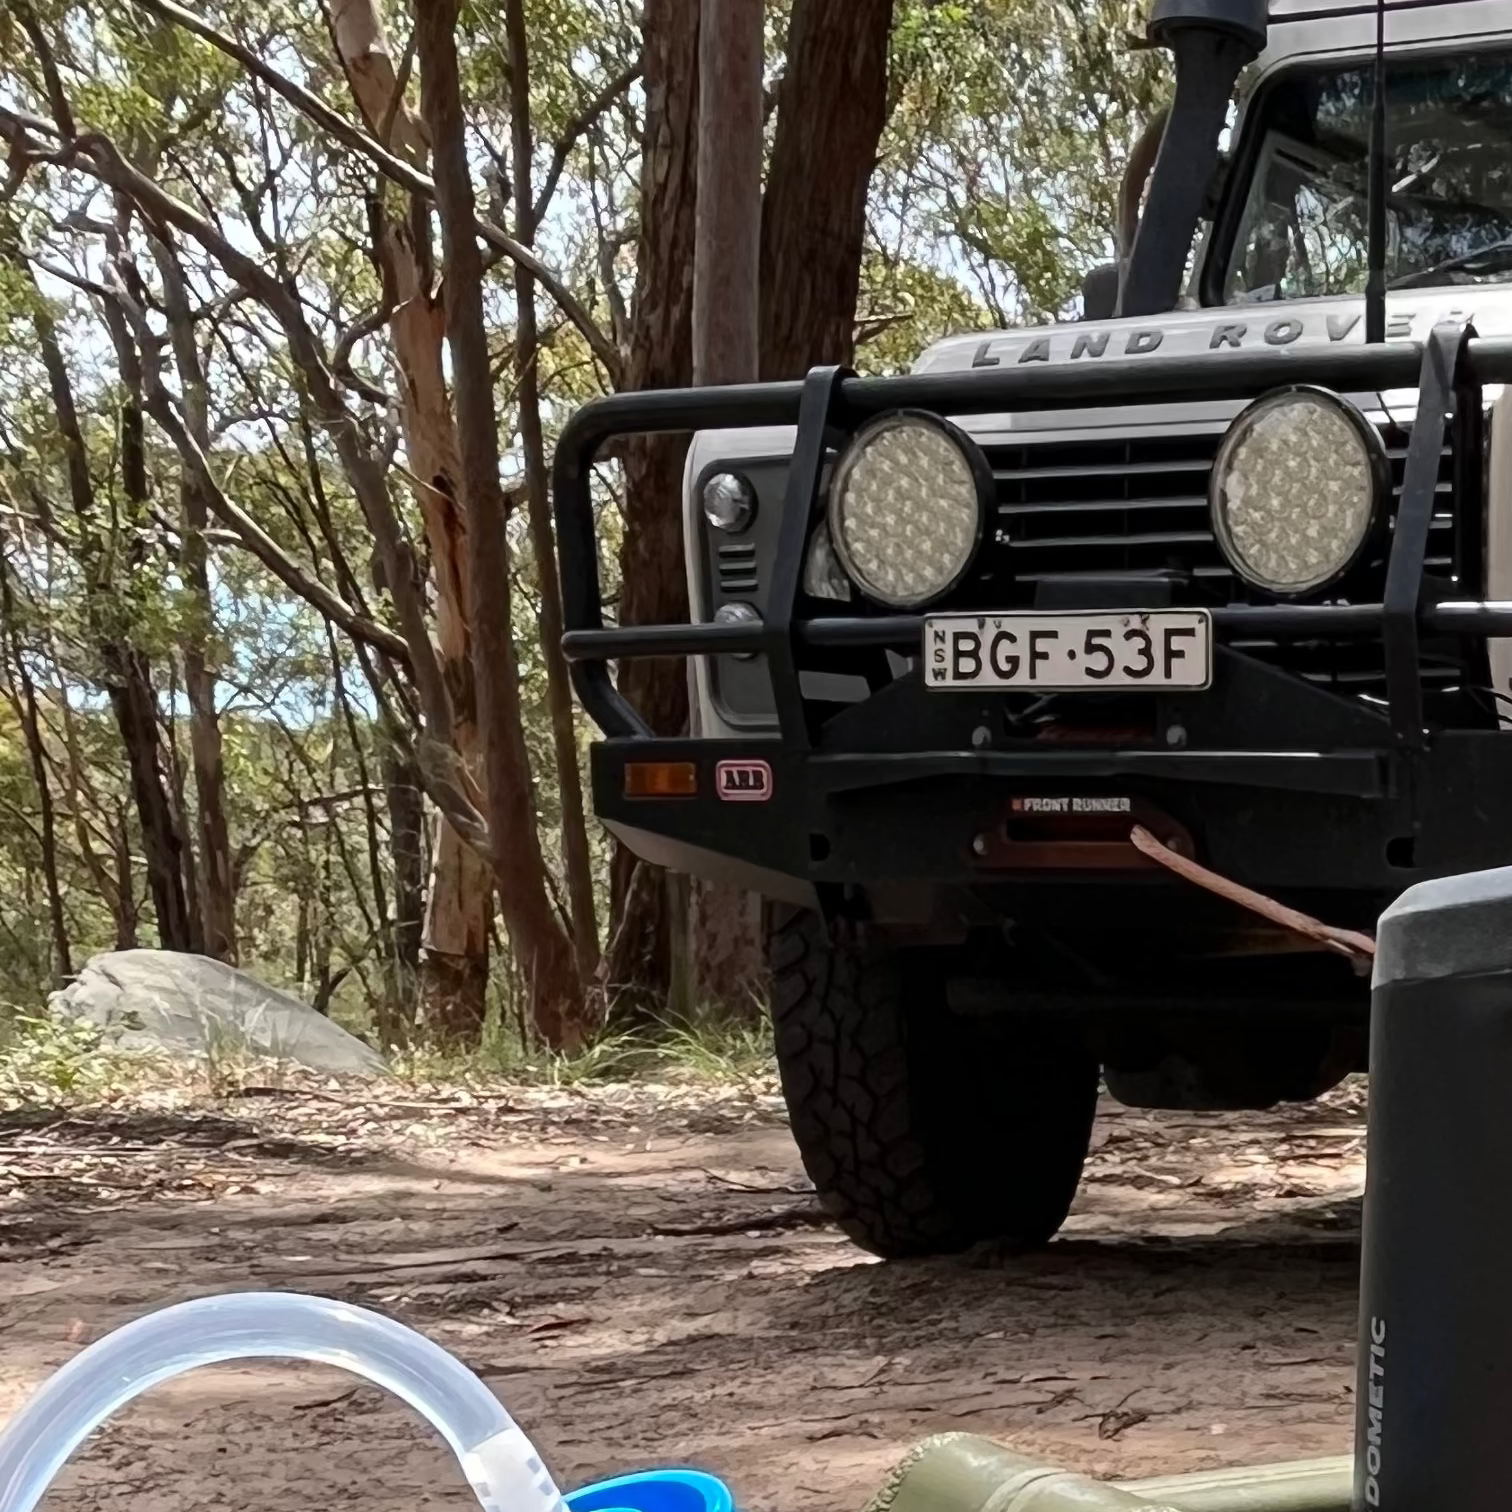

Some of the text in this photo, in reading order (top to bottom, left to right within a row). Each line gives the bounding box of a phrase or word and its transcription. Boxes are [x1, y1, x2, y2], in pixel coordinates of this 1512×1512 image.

[971, 328, 1164, 368] LAND
[931, 629, 948, 682] NSW
[1023, 797, 1069, 812] FRONT
[1364, 1315, 1387, 1508] DOMETIC
